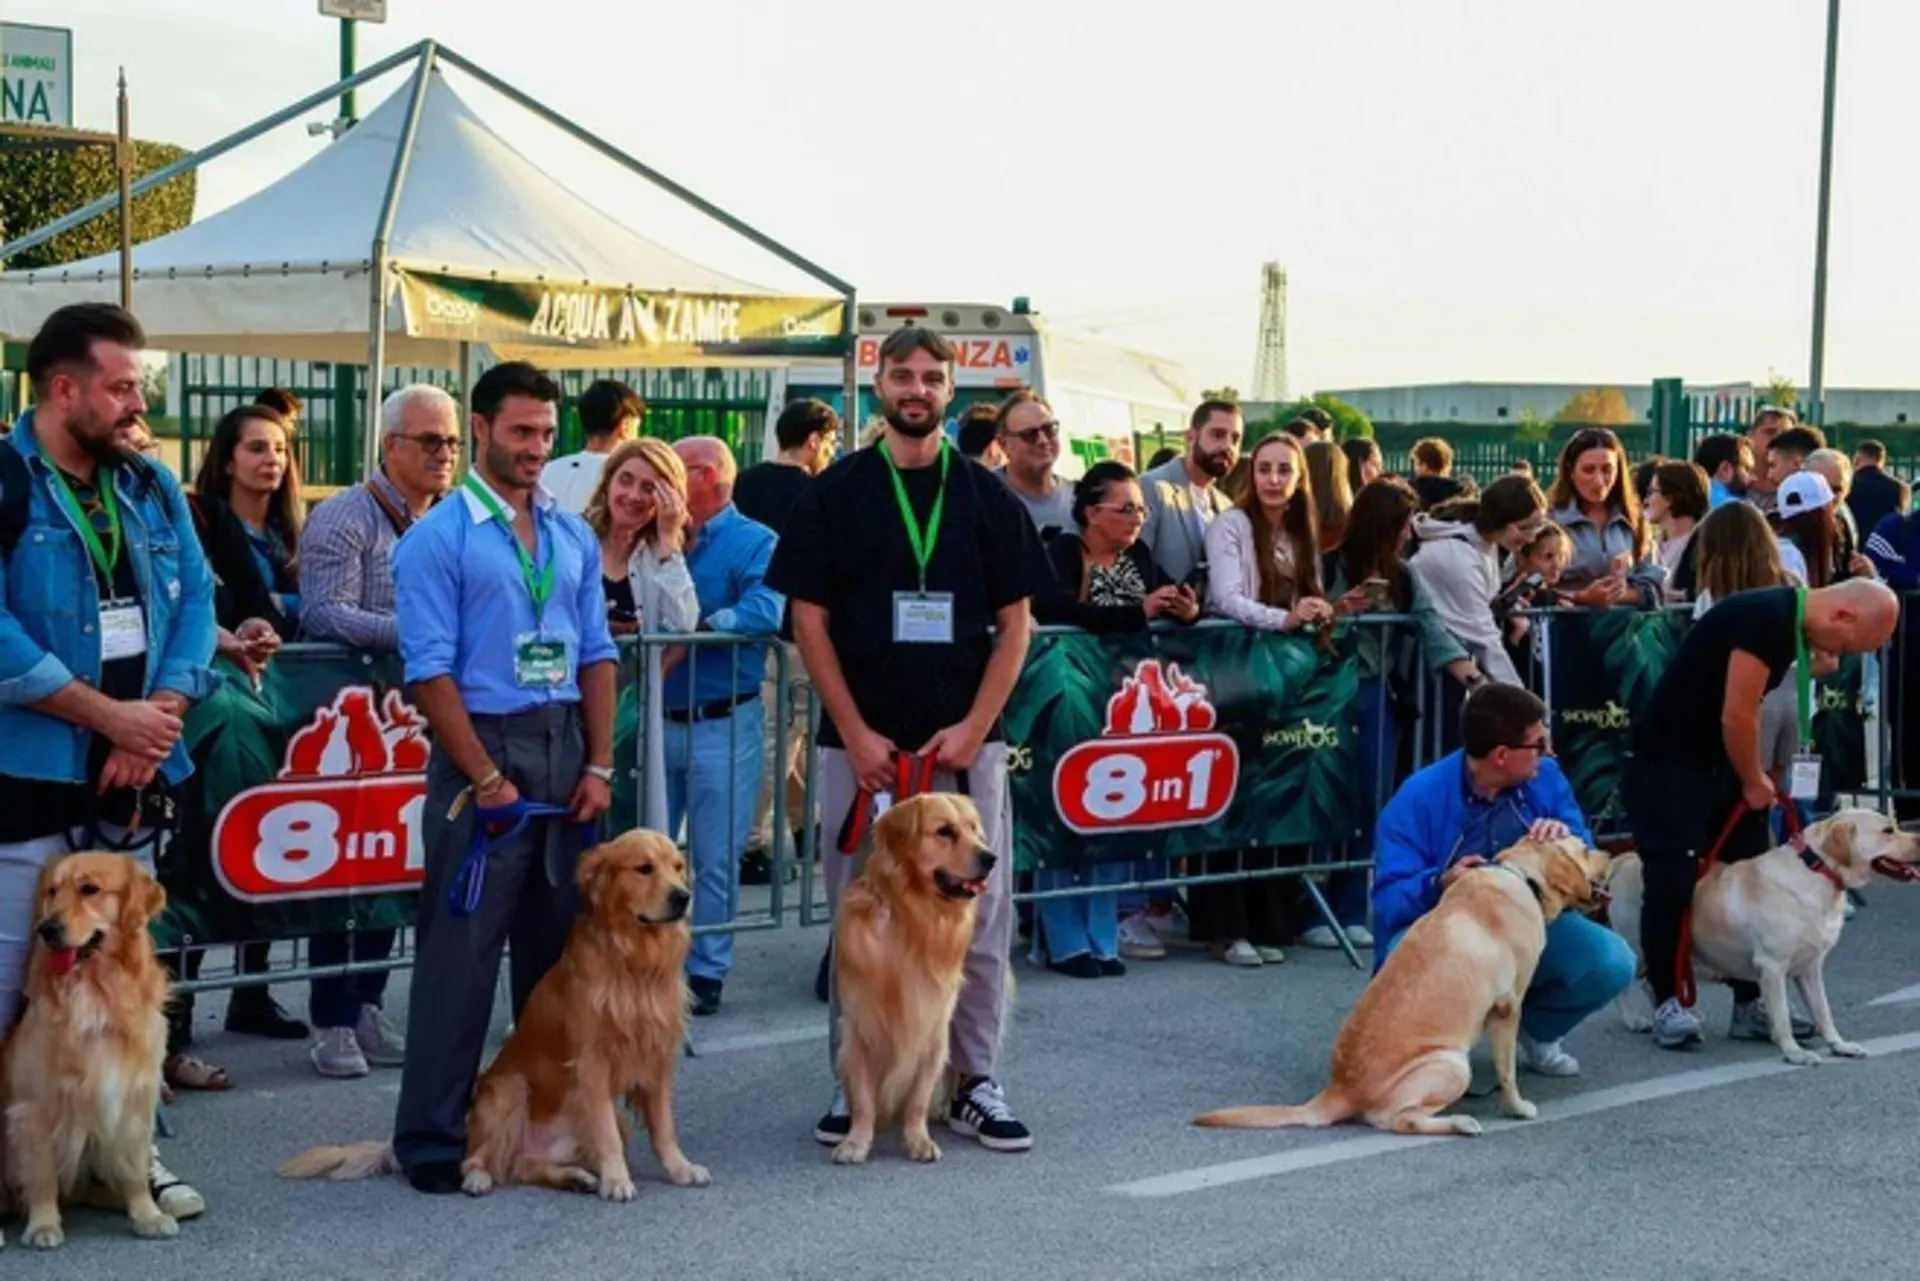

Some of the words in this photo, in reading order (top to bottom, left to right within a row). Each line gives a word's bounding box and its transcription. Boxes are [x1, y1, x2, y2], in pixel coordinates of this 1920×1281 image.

[530, 291, 609, 344] ACQUA
[666, 299, 740, 344] ZAMPE
[1082, 754, 1147, 819] 8
[1152, 776, 1182, 802] in
[253, 801, 340, 883] 8
[345, 830, 396, 860] in
